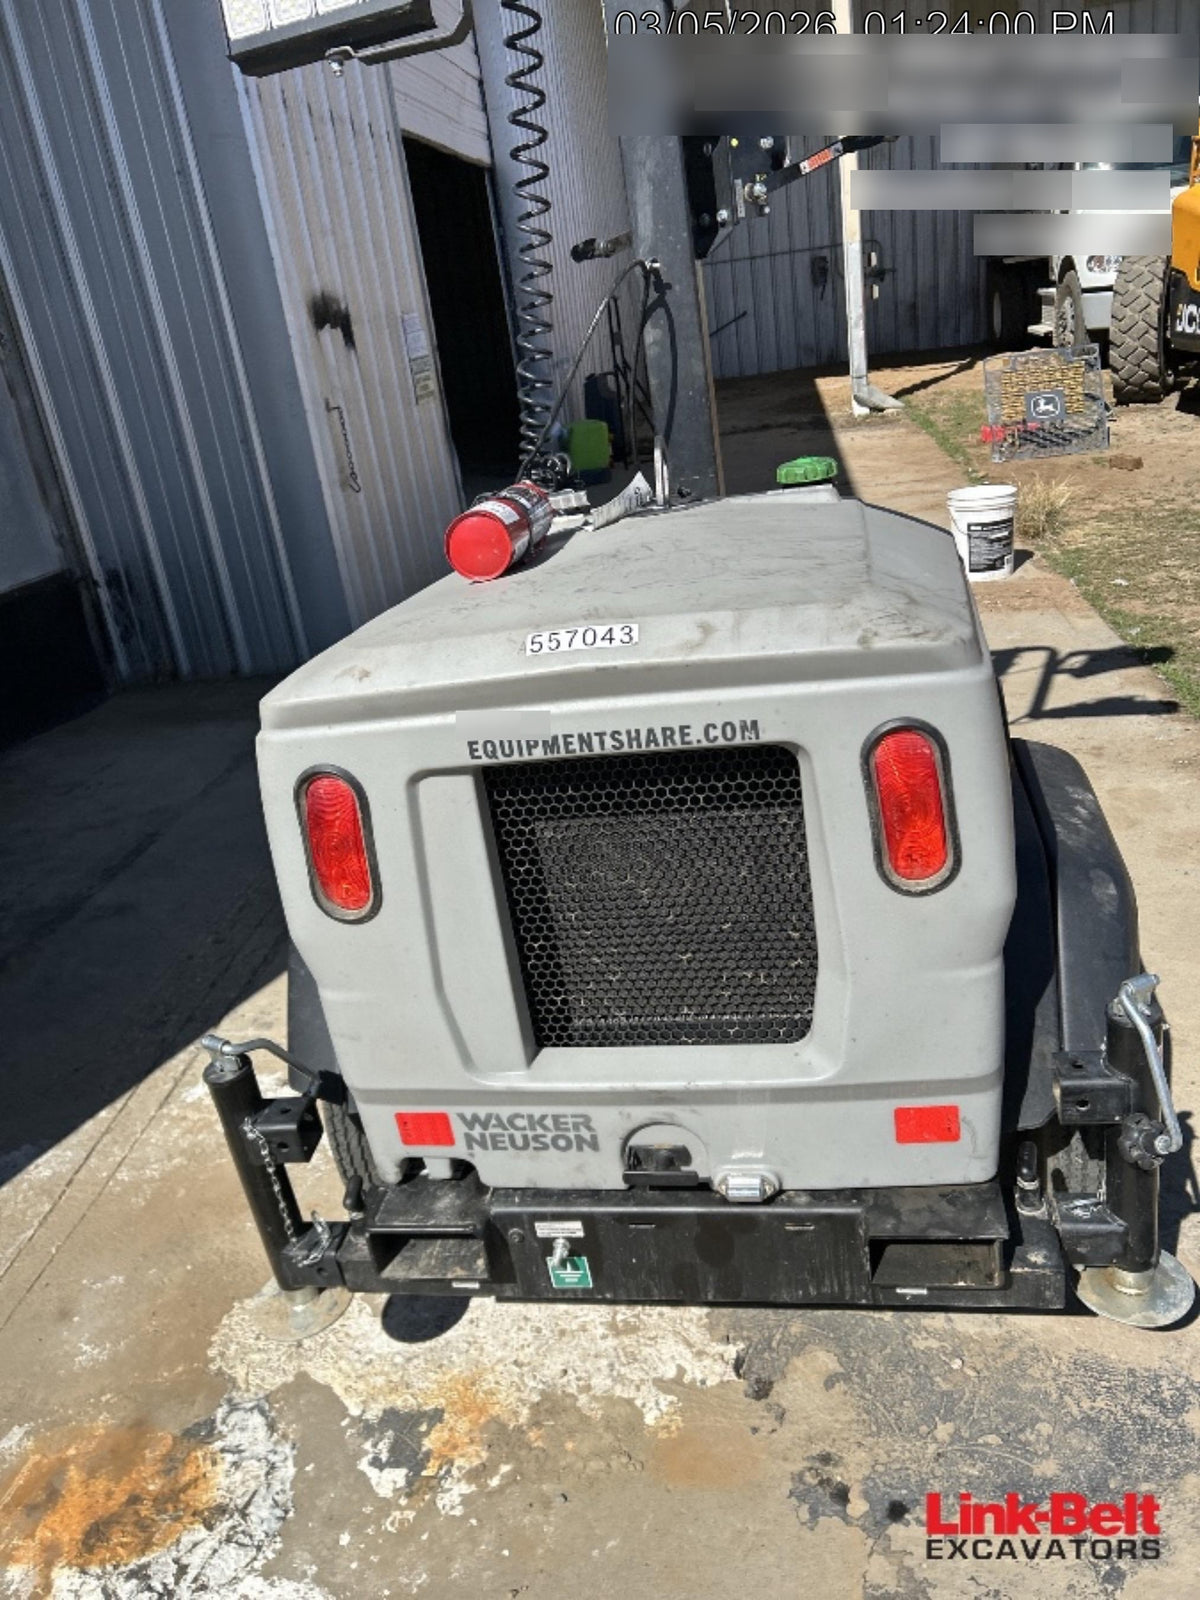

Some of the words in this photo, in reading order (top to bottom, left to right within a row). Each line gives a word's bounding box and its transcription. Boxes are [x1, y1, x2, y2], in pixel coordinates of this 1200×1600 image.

[529, 625, 634, 653] 557043
[467, 719, 760, 760] EQUIPMENTSHARE.COM
[455, 1112, 595, 1133] WACKER
[463, 1133, 600, 1152] NEUSON
